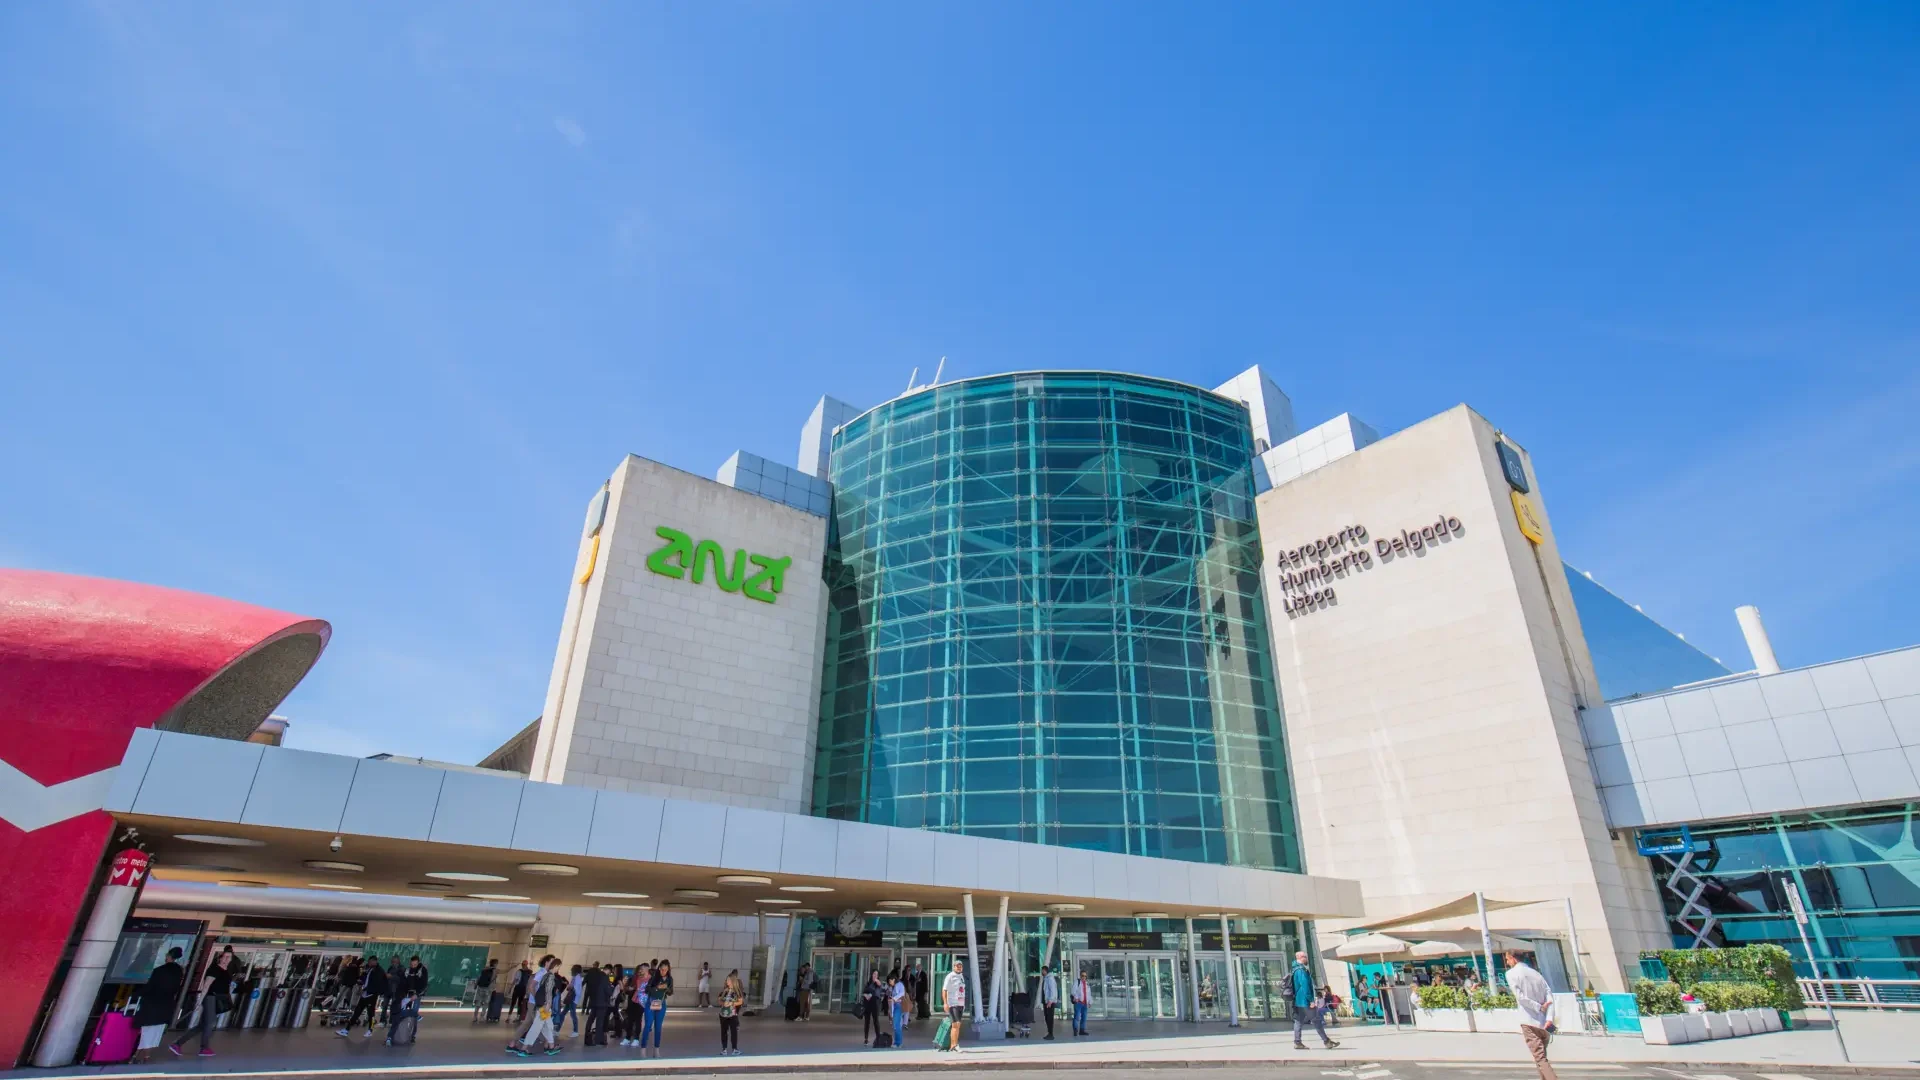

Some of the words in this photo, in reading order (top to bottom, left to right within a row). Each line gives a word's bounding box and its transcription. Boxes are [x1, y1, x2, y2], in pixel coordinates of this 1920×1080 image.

[1277, 523, 1367, 568] Aeroporto
[1278, 550, 1370, 592] Humberto
[1374, 514, 1463, 558] Delgado
[1282, 587, 1336, 614] Lisboa
